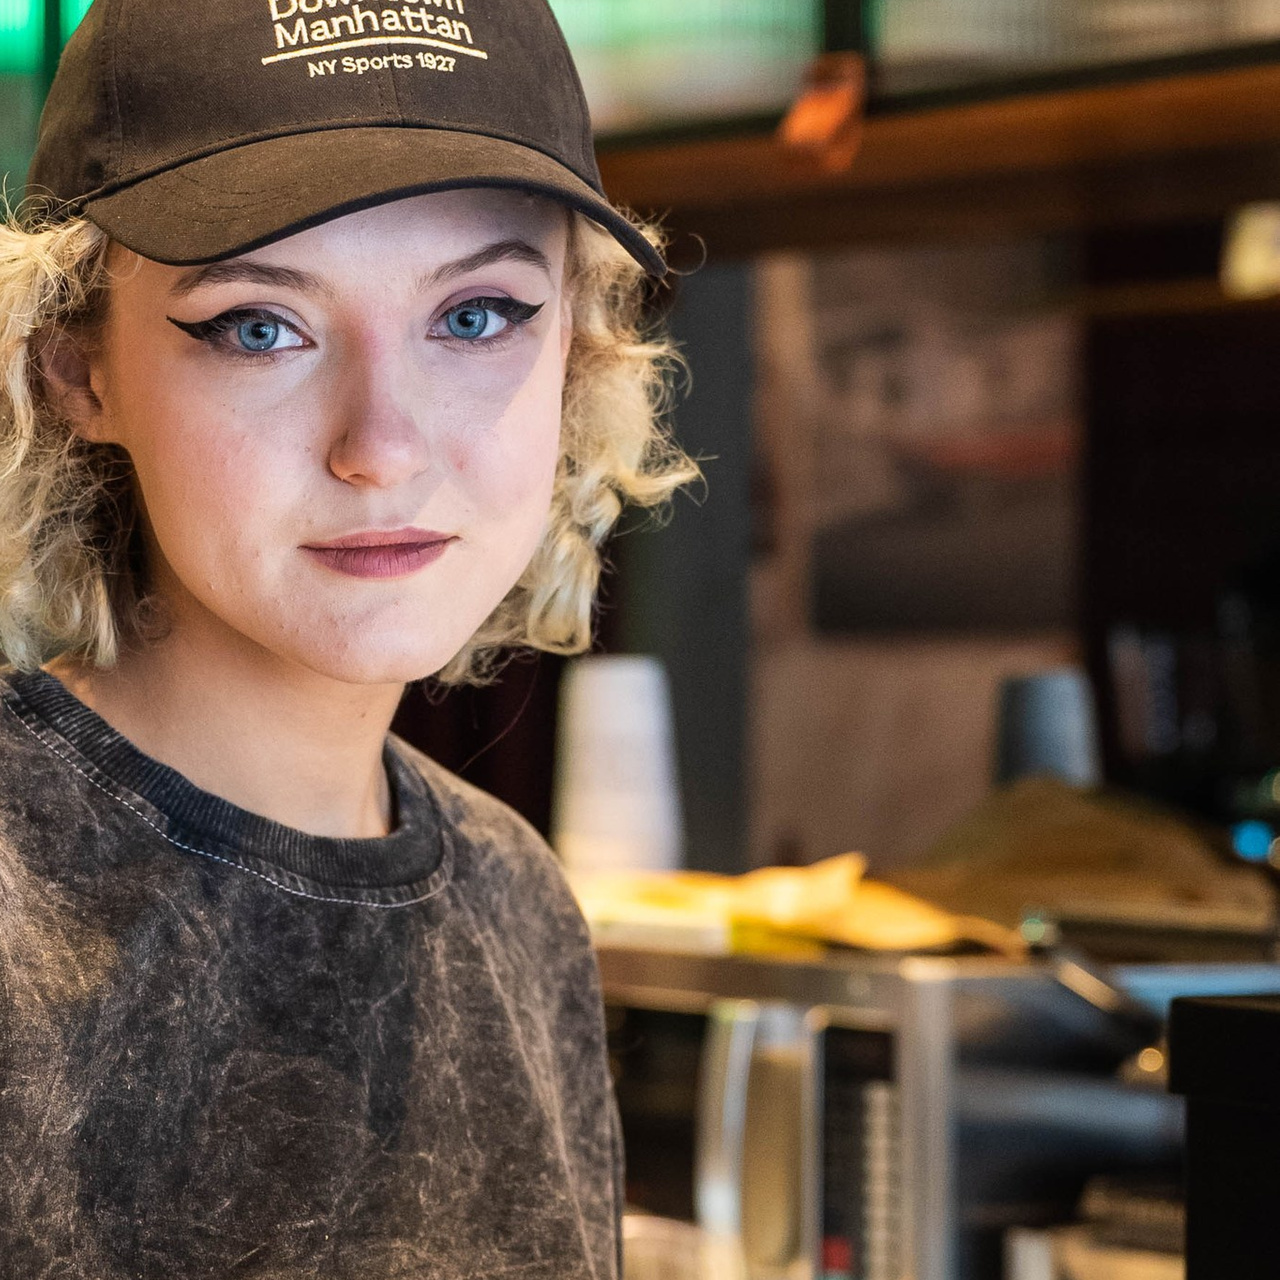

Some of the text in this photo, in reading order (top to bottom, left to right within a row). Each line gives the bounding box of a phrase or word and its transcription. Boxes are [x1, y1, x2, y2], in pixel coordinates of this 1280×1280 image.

[273, 4, 473, 49] Manhattan
[308, 52, 456, 78] NY Sports 1927
